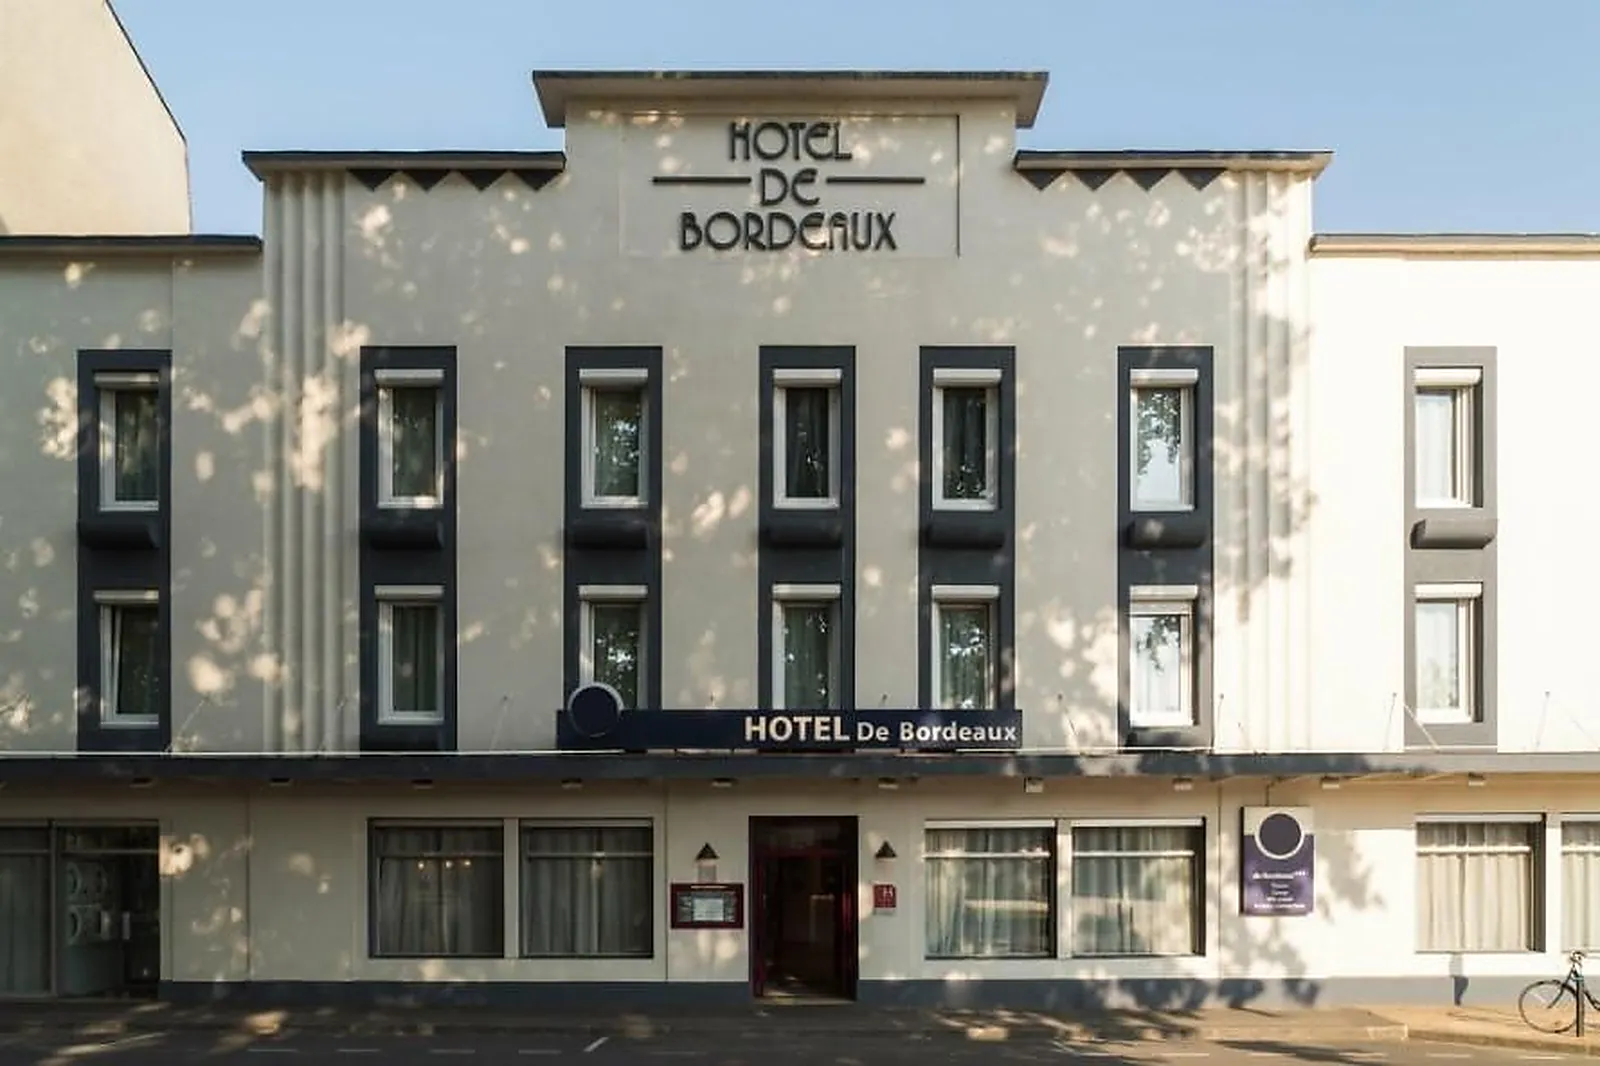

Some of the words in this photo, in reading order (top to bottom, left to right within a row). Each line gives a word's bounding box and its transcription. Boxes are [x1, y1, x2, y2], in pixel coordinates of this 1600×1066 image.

[729, 121, 852, 160] HOTEL
[759, 168, 821, 206] DE
[680, 212, 897, 251] BORDEAUX
[745, 716, 849, 741] HOTEL
[857, 723, 889, 741] De
[900, 721, 1016, 741] Bordeaux
